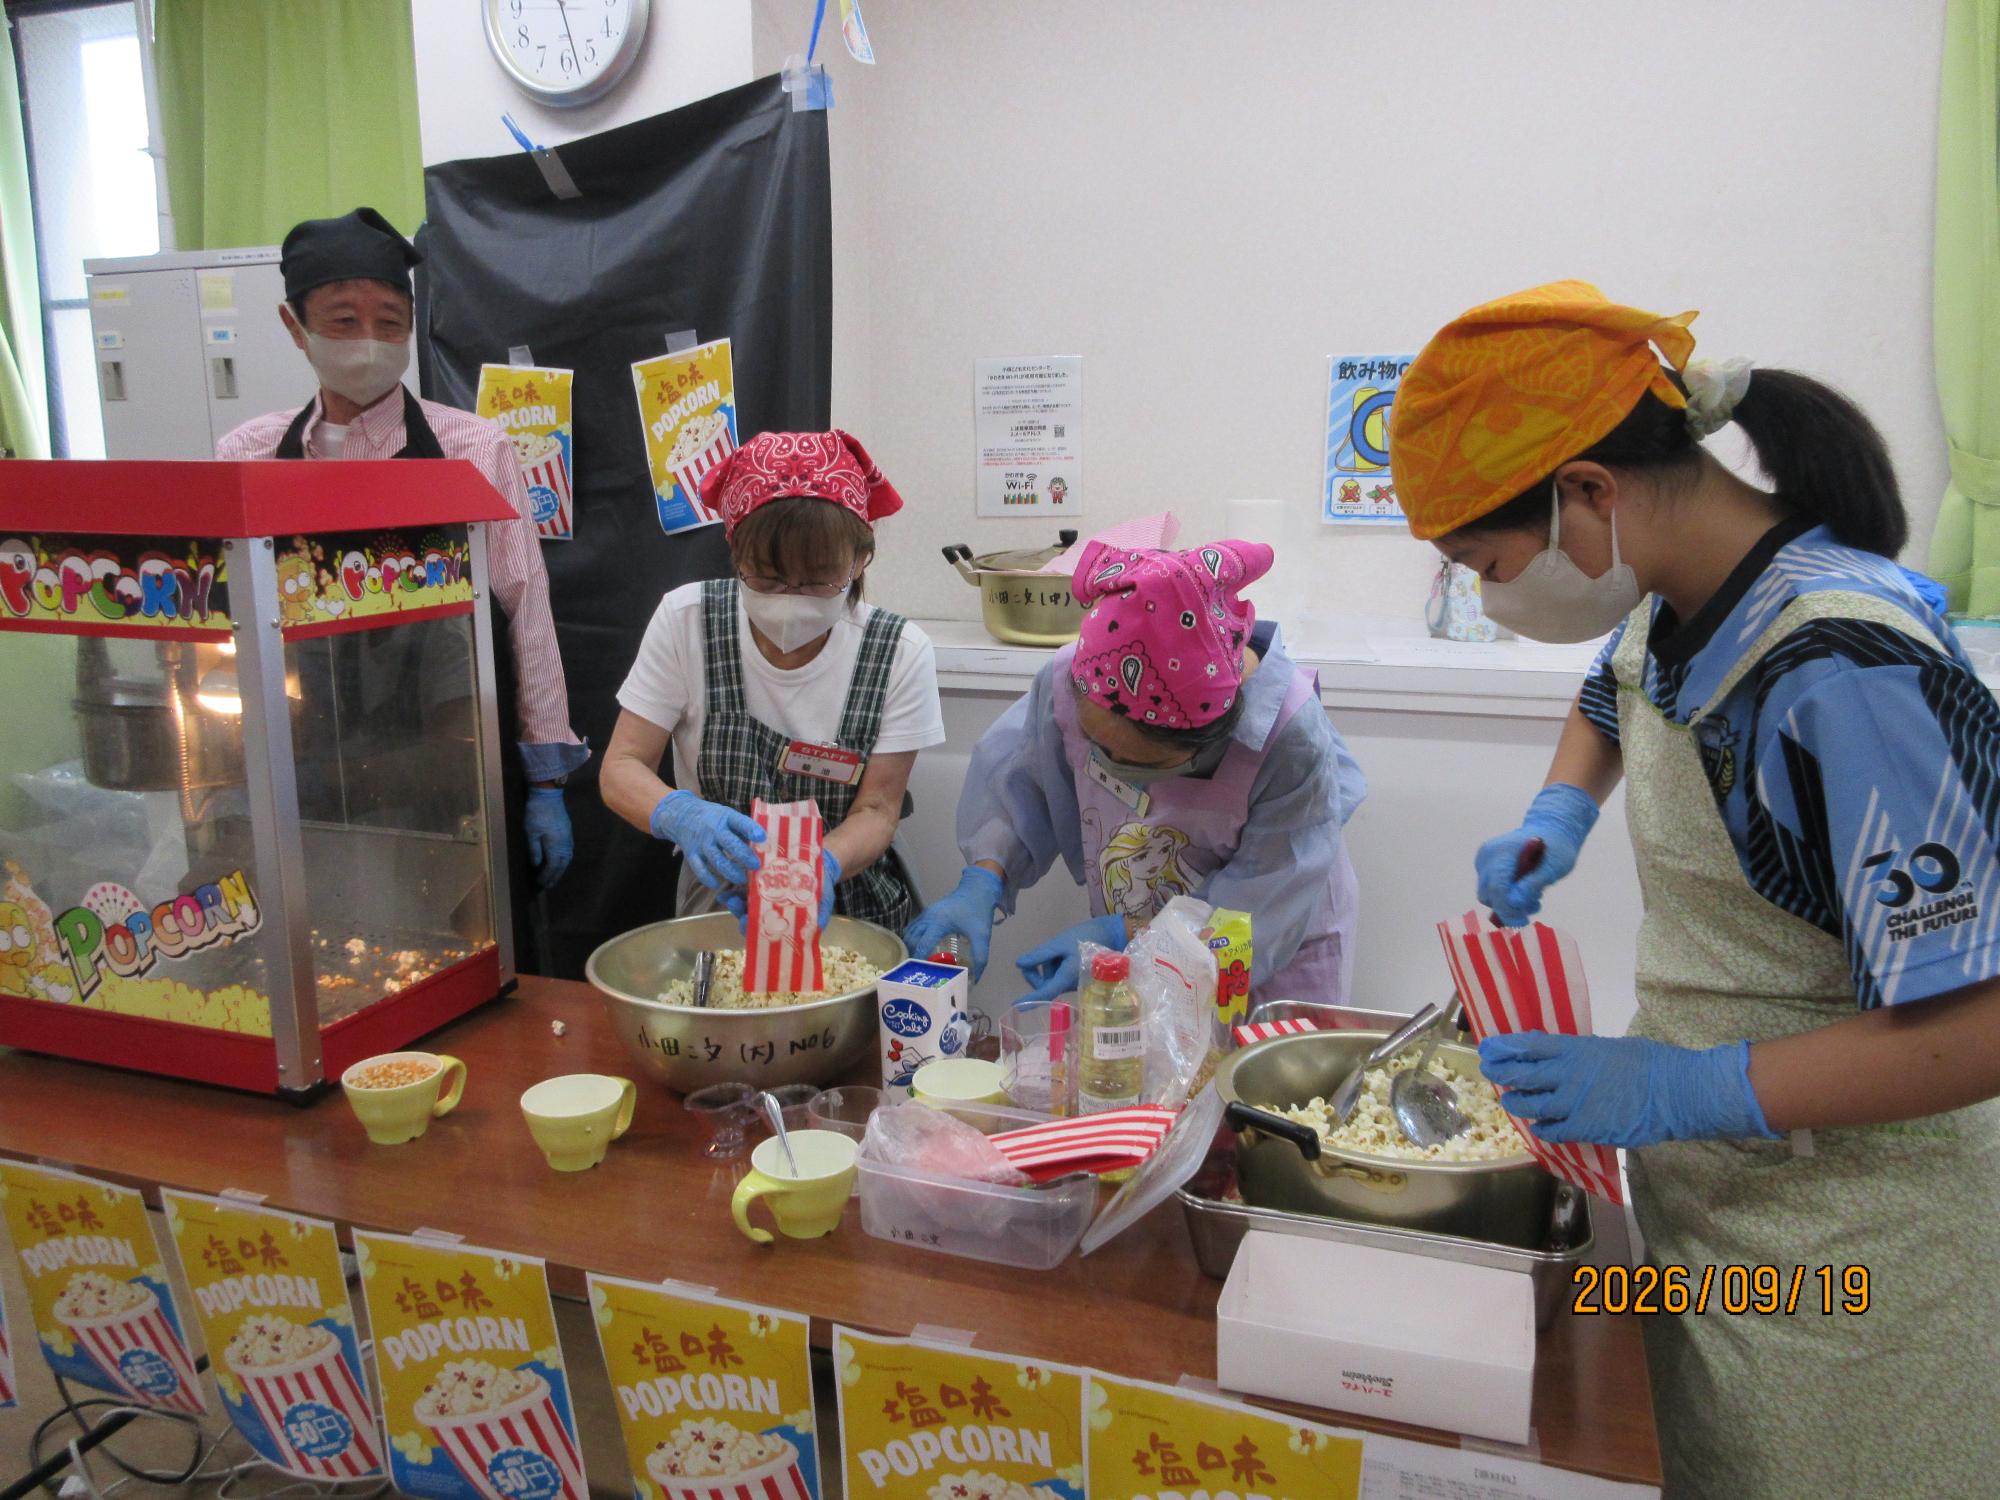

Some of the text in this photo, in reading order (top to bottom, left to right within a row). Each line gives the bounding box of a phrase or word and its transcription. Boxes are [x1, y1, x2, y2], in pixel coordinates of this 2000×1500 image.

[518, 23, 530, 49] 8
[600, 15, 613, 38] 4
[536, 45, 547, 69] 7
[560, 47, 573, 73] 6
[584, 39, 596, 63] 5
[651, 380, 721, 443] POPCORN
[1005, 481, 1034, 491] Wi-Fi
[0, 538, 215, 620] POPCORN
[341, 551, 463, 602] POPCORN
[799, 746, 850, 762] STAFF
[1886, 891, 1975, 928] CHALLENGE
[1888, 905, 1979, 943] THE FUTURE
[54, 869, 261, 1001] POPCORN
[883, 1003, 929, 1027] Cooking
[899, 1017, 924, 1034] Salt
[26, 1195, 104, 1236] 塩味
[21, 1235, 139, 1278] POPCORN
[202, 1228, 289, 1274] 塩味
[195, 1273, 322, 1320] POPCORN
[395, 1269, 495, 1321] 塩味
[382, 1315, 532, 1371] POPCORN
[631, 1322, 745, 1374] 塩味
[616, 1373, 781, 1421] POPCORN
[881, 1375, 1012, 1429] 塩味
[1341, 1381, 1393, 1398] ユーハイム
[287, 1414, 347, 1448] 50円
[493, 1460, 555, 1493] 50円
[857, 1424, 1054, 1488] POPCORN
[1132, 1431, 1277, 1489] 塩味
